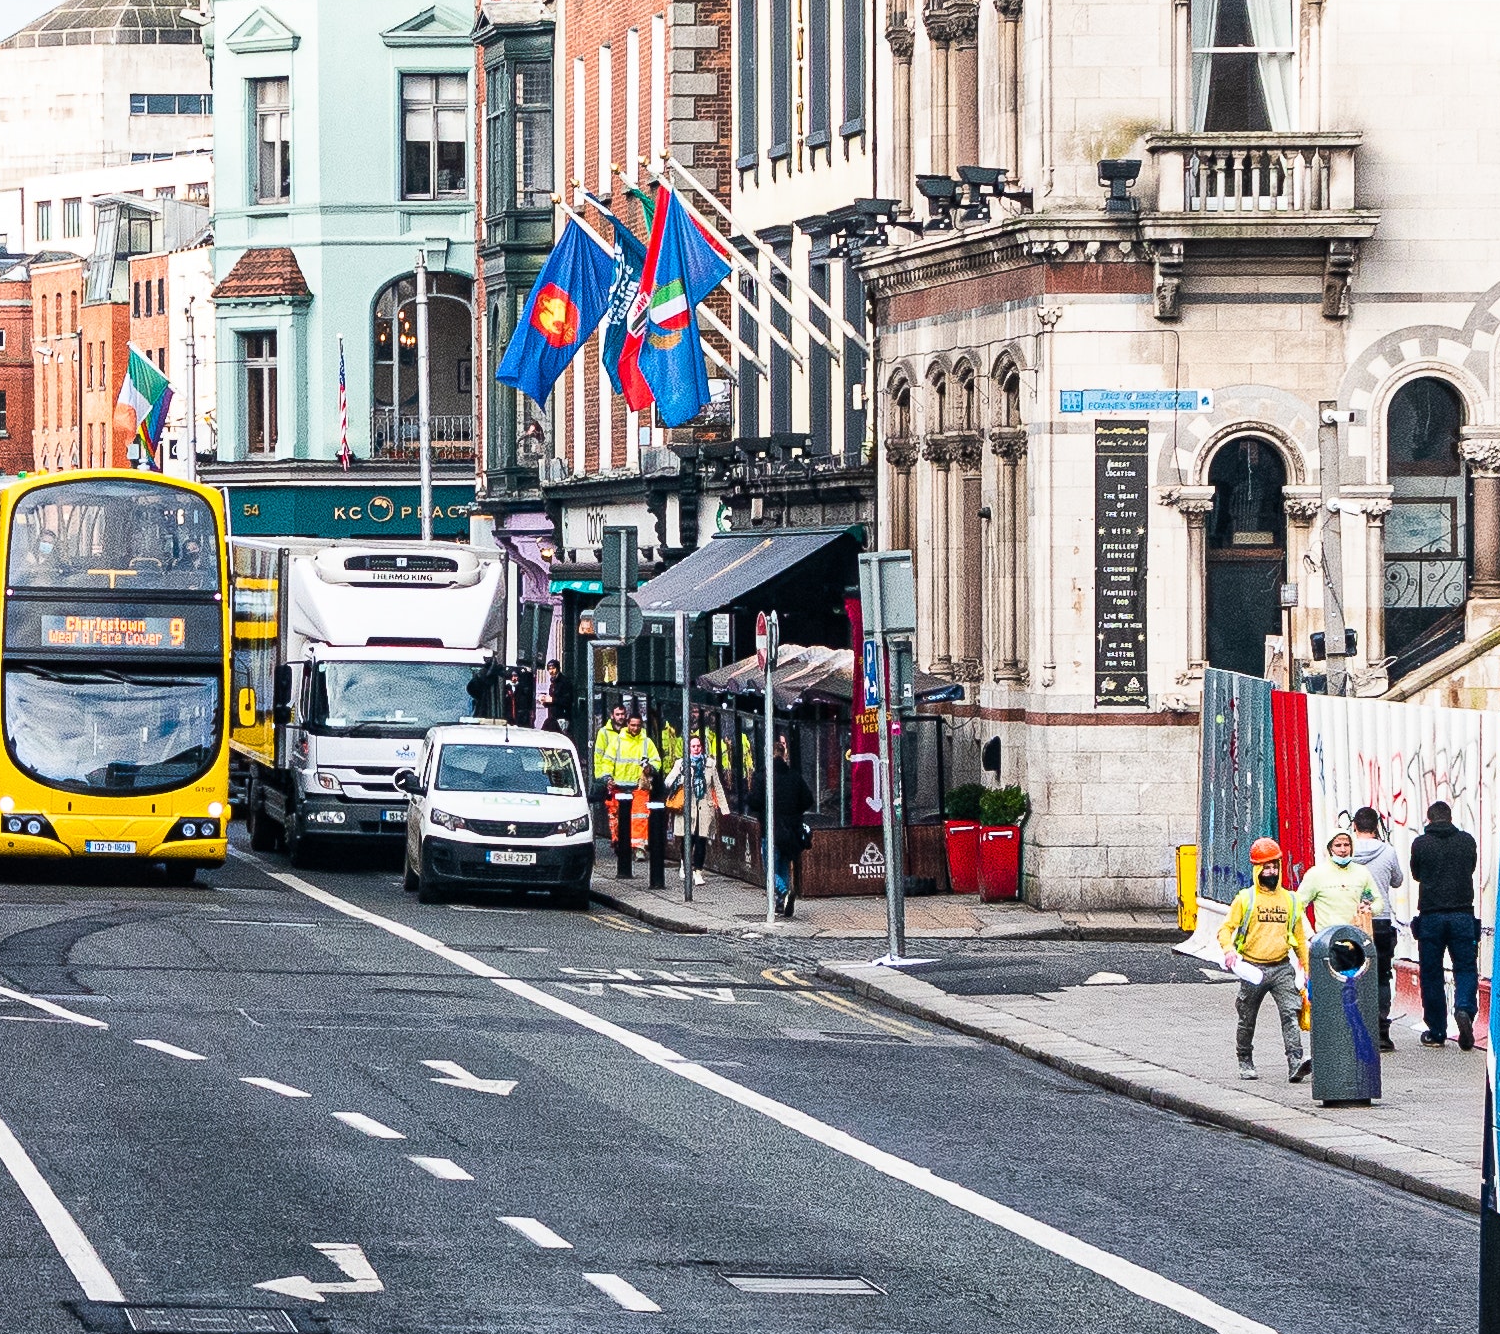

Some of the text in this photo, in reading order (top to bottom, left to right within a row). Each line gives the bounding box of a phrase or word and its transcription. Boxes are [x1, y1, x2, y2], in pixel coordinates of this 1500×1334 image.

[243, 504, 260, 516] 54
[334, 506, 468, 519] KC PEAC
[372, 573, 434, 582] THERMO KING
[65, 616, 147, 633] Charlestown
[48, 629, 163, 646] Wear A Face Cover
[169, 617, 186, 646] 9
[855, 712, 892, 722] TICKS
[862, 724, 880, 734] HER
[849, 863, 886, 875] TRINIT
